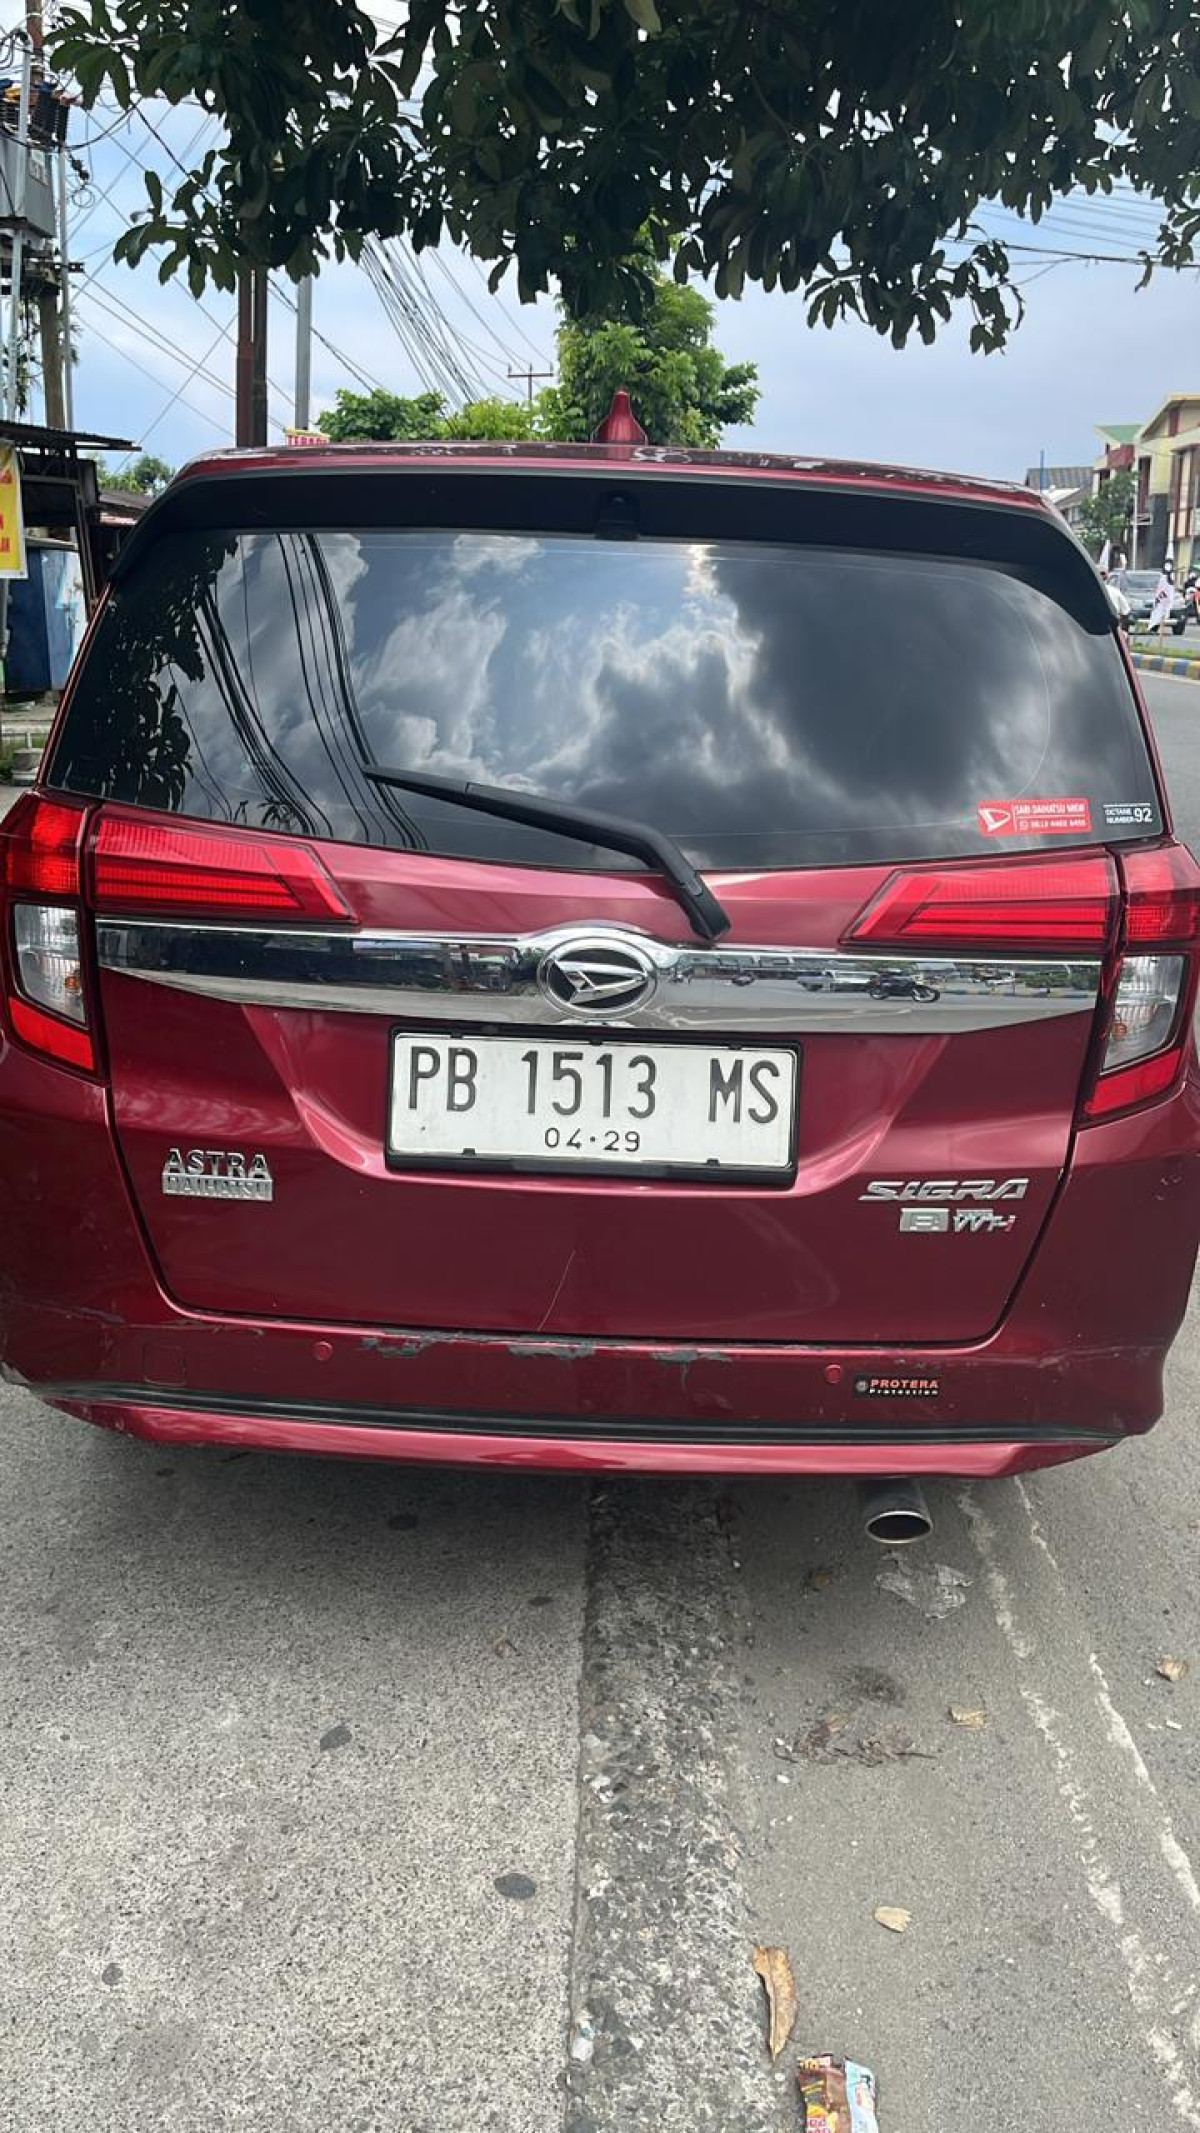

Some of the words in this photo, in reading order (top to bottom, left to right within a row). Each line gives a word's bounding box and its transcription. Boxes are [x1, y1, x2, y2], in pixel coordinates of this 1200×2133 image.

[1134, 808, 1153, 823] 92
[408, 1045, 478, 1112] PB
[521, 1049, 657, 1119] 1513
[707, 1057, 780, 1124] MS
[163, 1147, 271, 1180] ASTRA
[162, 1175, 272, 1201] DAIHATSU
[859, 1177, 1029, 1201] SIGRA
[870, 1379, 938, 1389] PROTERA
